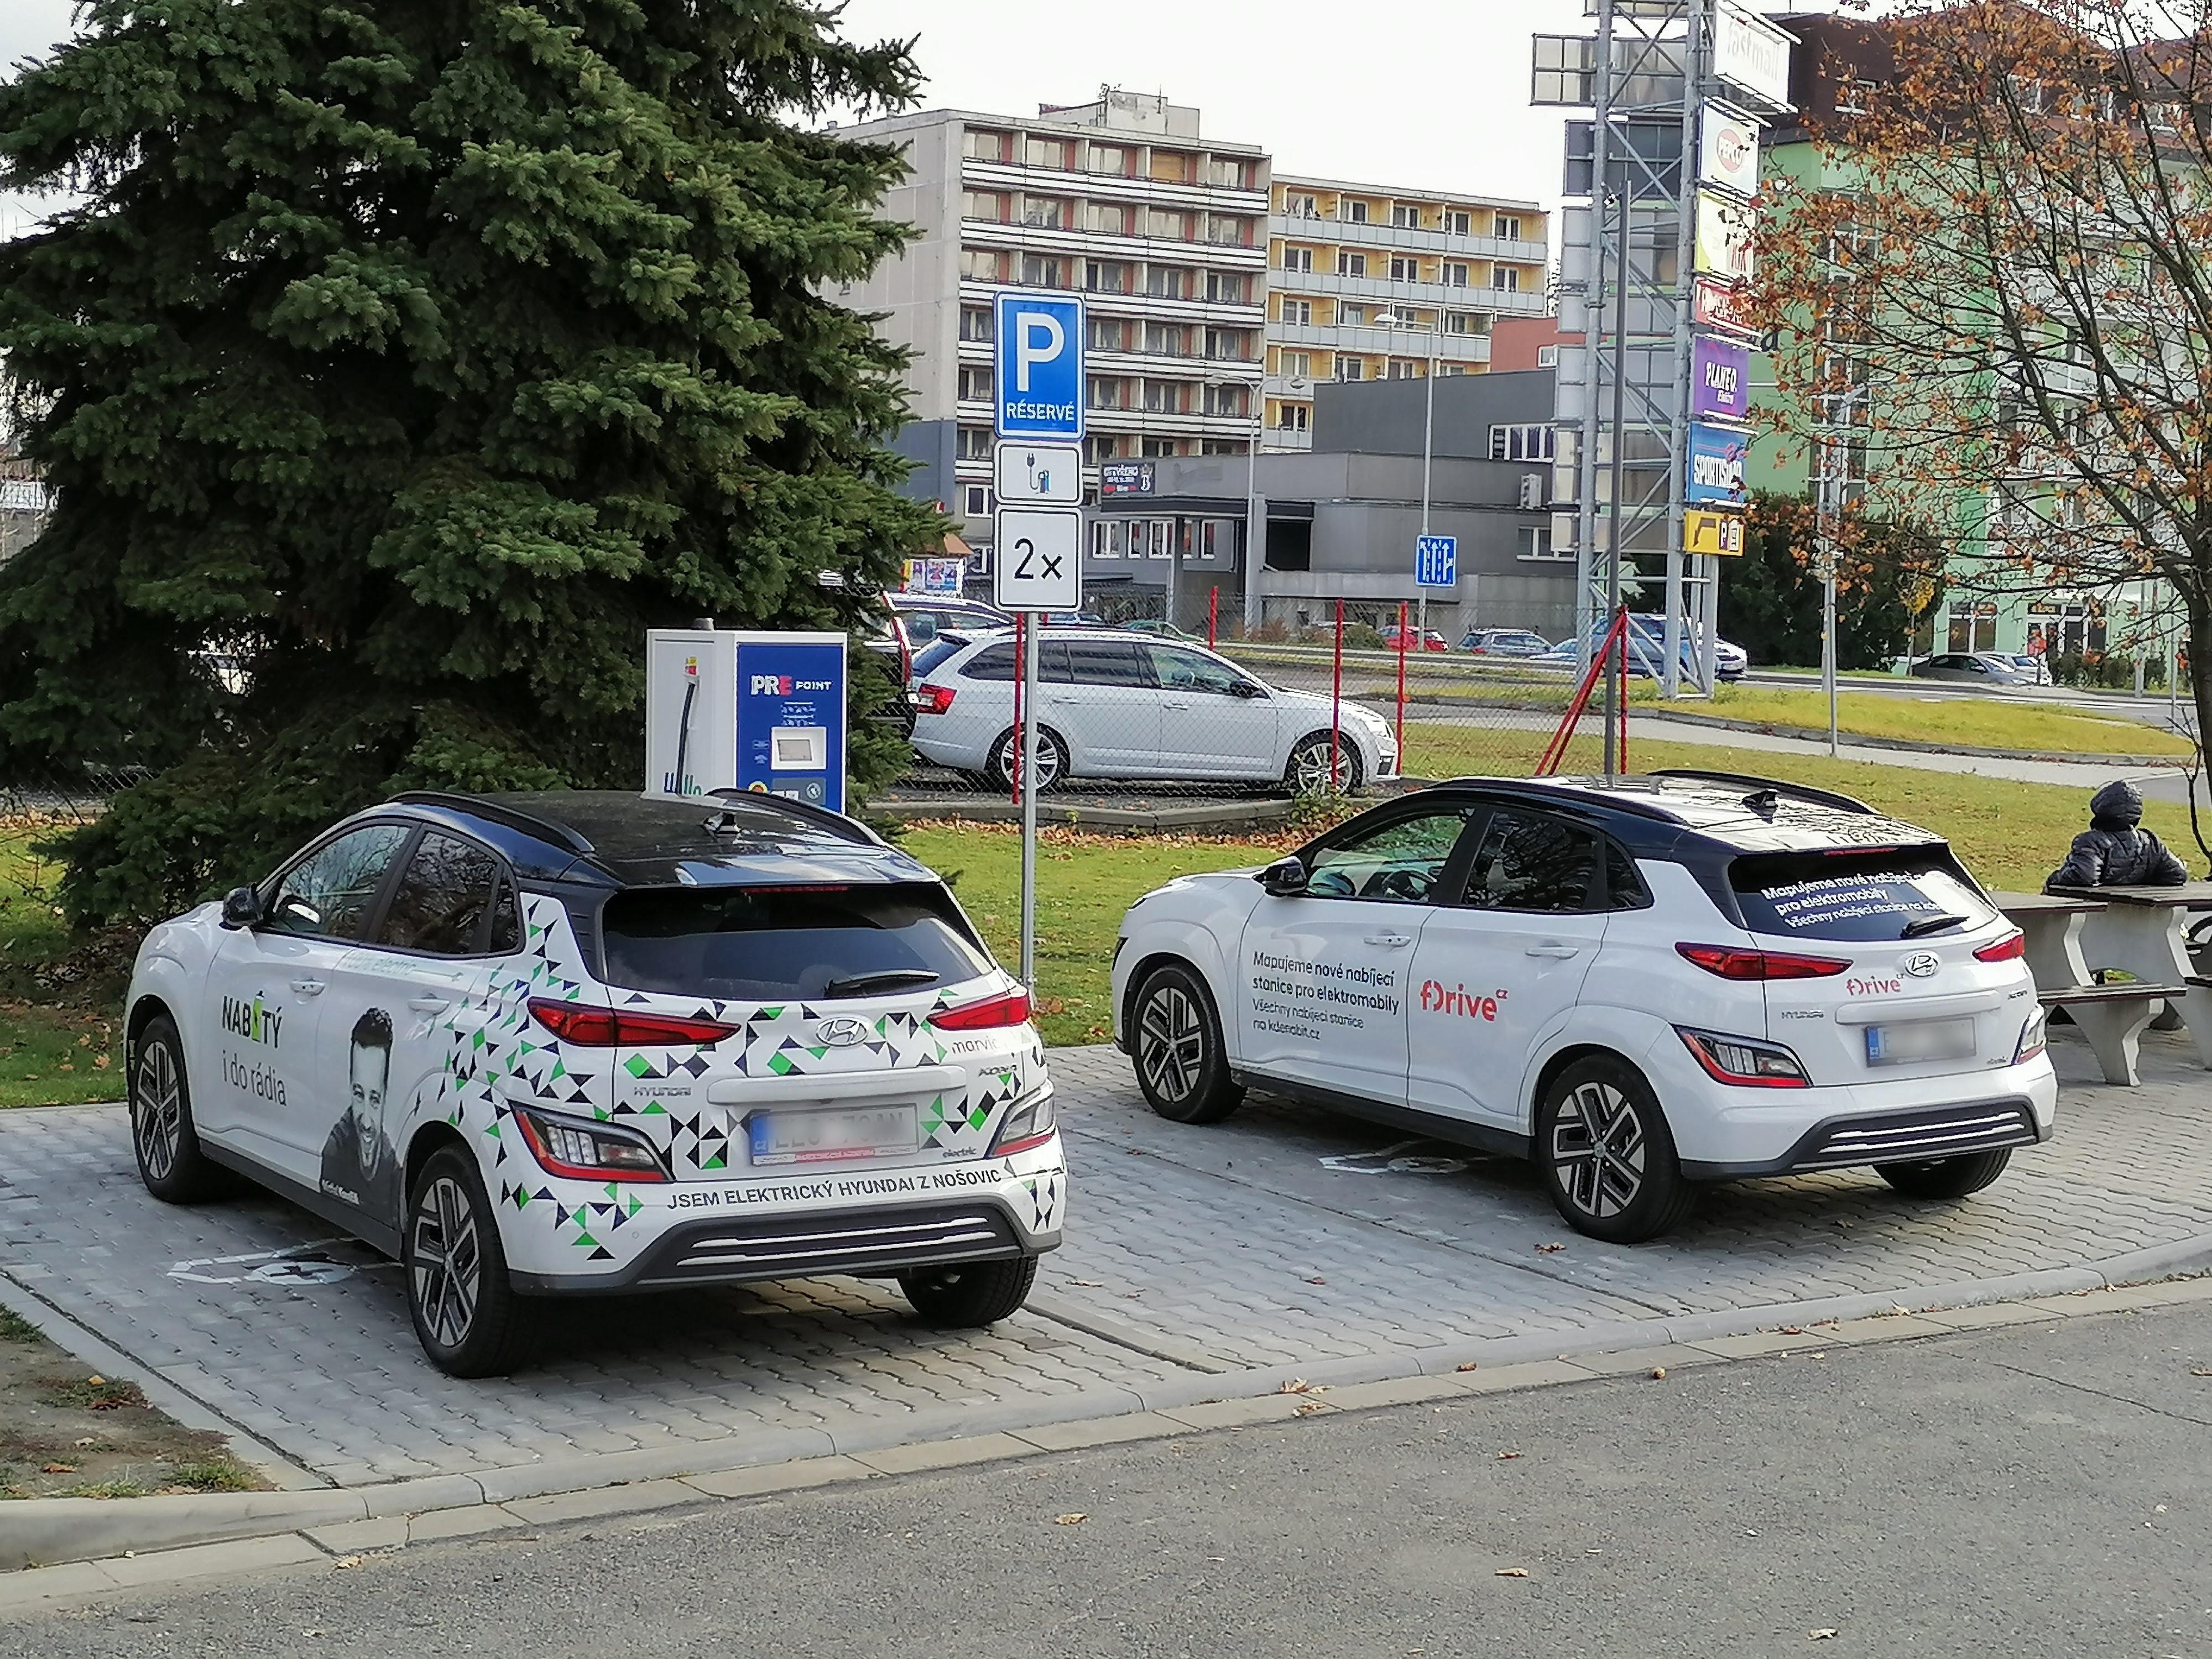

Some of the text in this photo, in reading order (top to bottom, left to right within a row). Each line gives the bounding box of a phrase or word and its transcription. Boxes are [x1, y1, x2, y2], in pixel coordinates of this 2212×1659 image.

[1016, 311, 1065, 392] P
[1006, 399, 1076, 421] RÉSERVÉ
[1014, 538, 1063, 580] 2x
[750, 675, 832, 696] PRE POINT
[1761, 880, 1836, 901] Mapujeme
[1834, 874, 1867, 887] nové
[1775, 887, 1888, 916] pro elektromobily
[1253, 951, 1312, 974] Mapujeme
[1315, 963, 1343, 979] nové
[1253, 975, 1399, 1015] stanice pro elektromobily
[1252, 998, 1291, 1018] Všechny
[1329, 1013, 1364, 1028] stanice
[1253, 1020, 1266, 1030] na
[222, 1049, 286, 1107] i do rádia
[634, 1087, 691, 1097] HYUNDAI
[667, 1168, 1002, 1210] JSEM ELEKTRICKÝ HYUNDAI Z NOŠOVIC
